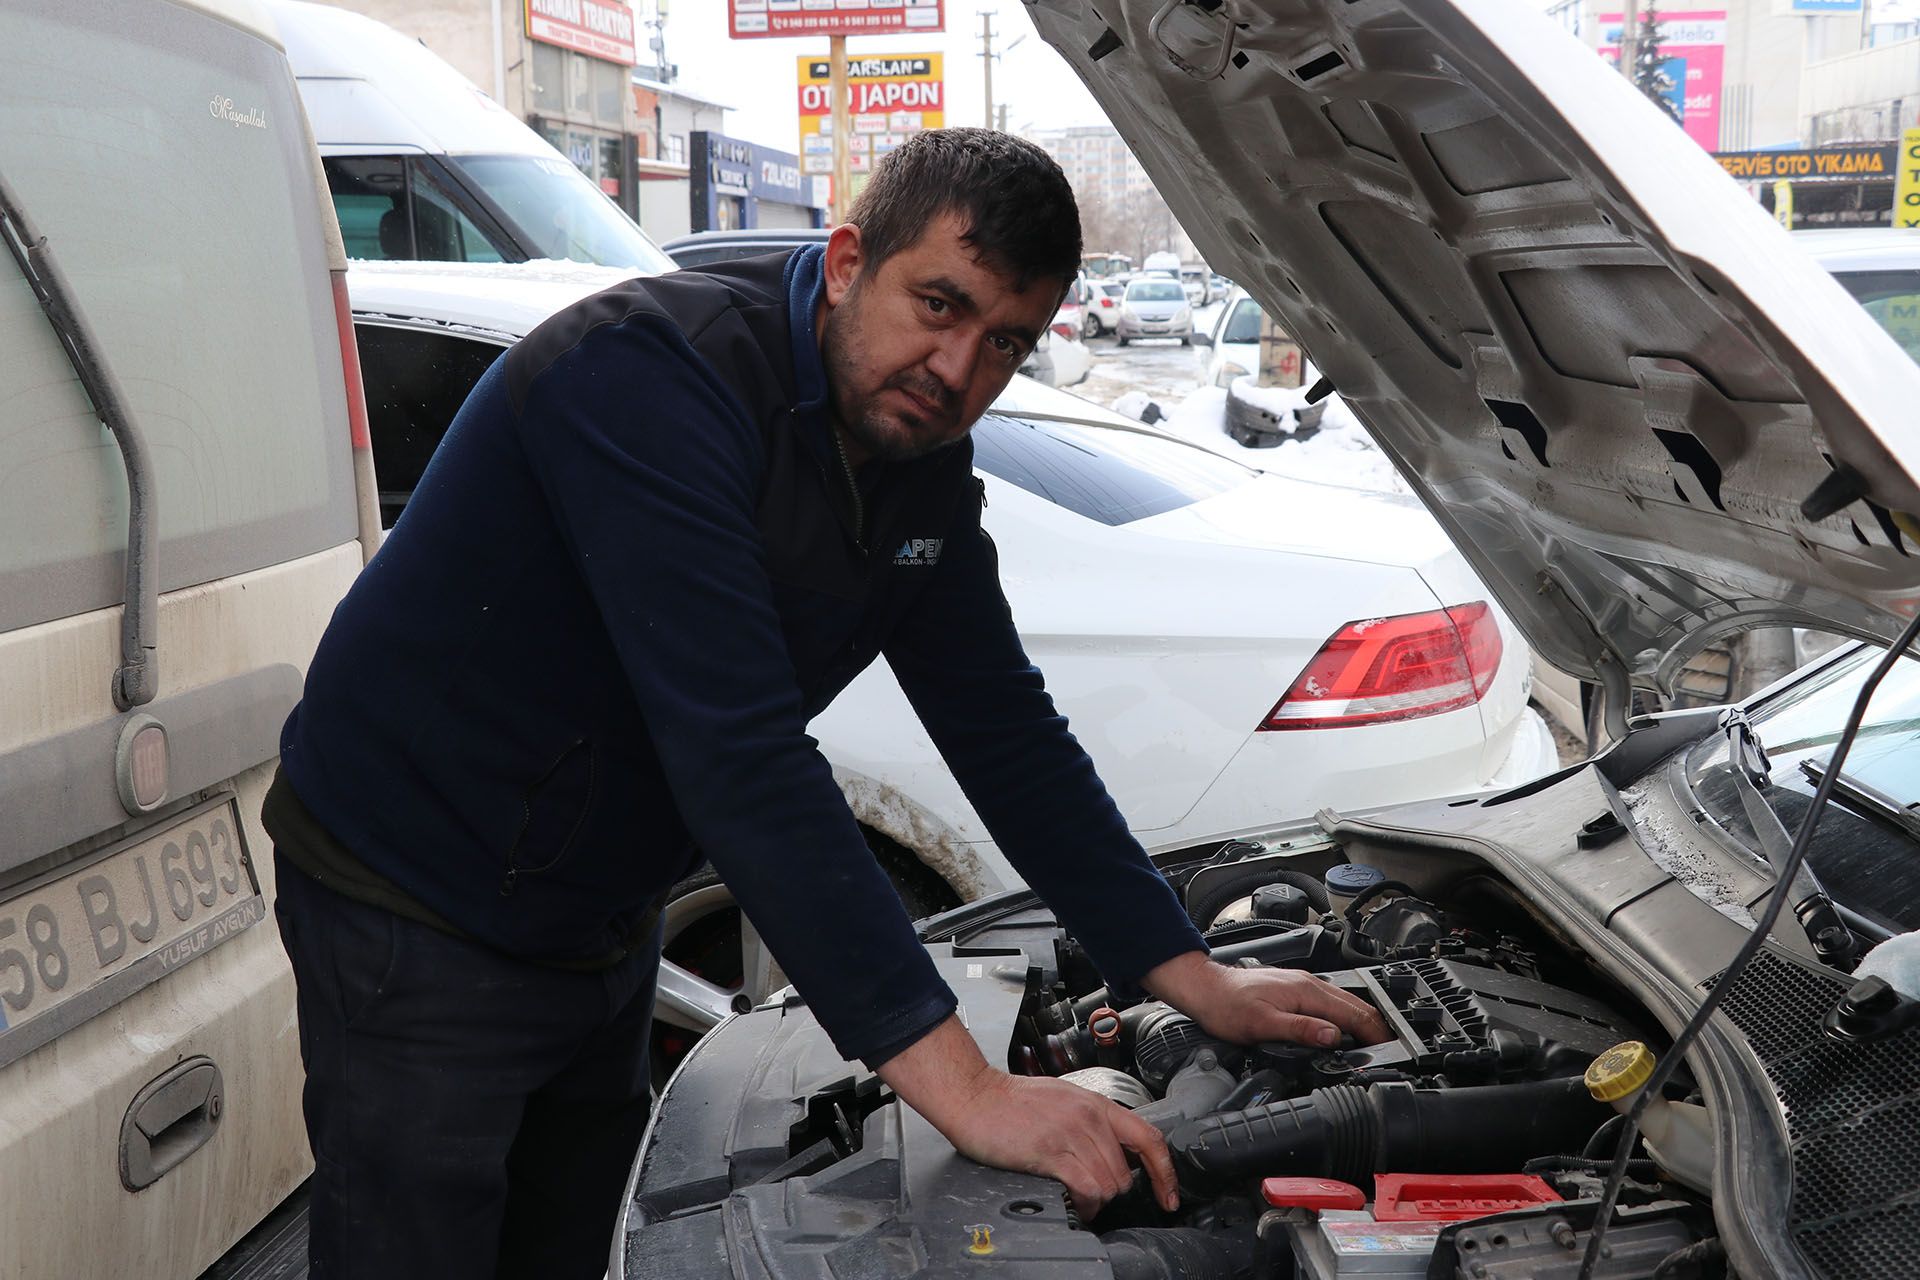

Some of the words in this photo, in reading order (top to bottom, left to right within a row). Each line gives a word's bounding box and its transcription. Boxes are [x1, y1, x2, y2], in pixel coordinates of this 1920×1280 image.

[847, 59, 912, 76] ARSLAN
[802, 84, 853, 109] OT
[860, 81, 939, 112] JAPON
[1775, 155, 1811, 174] OTO
[1814, 152, 1884, 172] YIKAMA
[157, 928, 208, 969] YUSUF
[213, 903, 257, 942] AYGÜN
[0, 903, 69, 1011] 58
